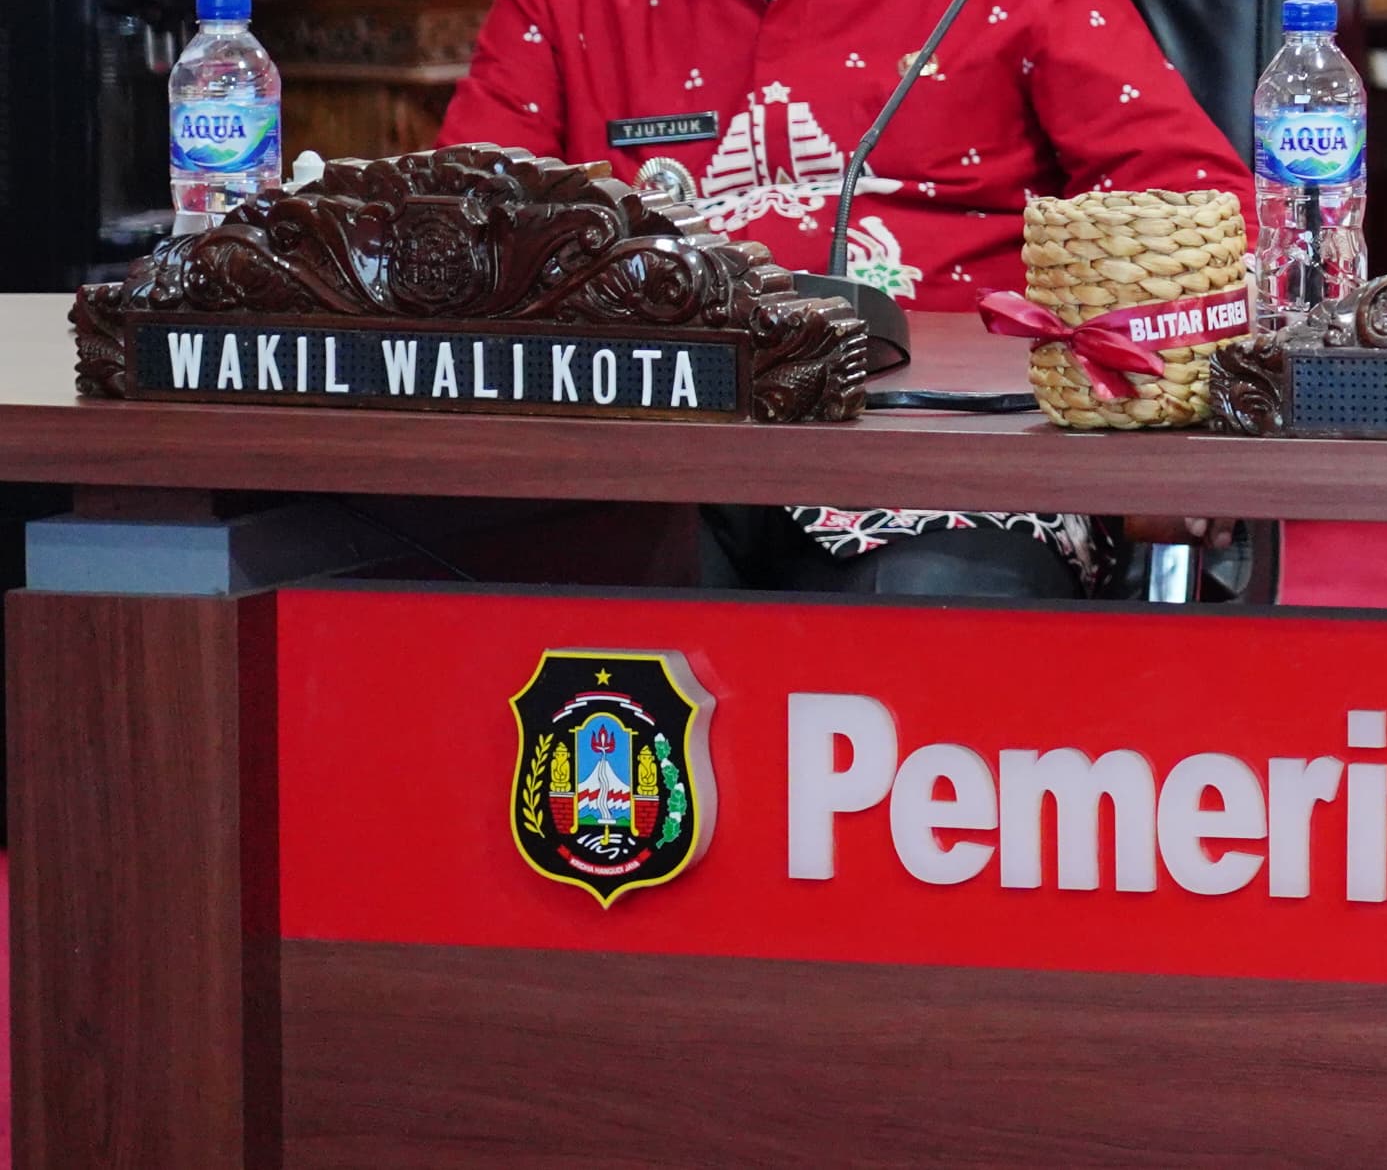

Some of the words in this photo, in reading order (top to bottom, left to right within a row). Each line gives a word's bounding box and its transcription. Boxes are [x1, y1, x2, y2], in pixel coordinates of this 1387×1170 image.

[181, 114, 247, 144] AQUA
[622, 119, 701, 138] TJUTJUK
[1279, 126, 1348, 156] AQUA
[1128, 308, 1204, 343] BLITAR
[167, 332, 350, 394] WAKIL
